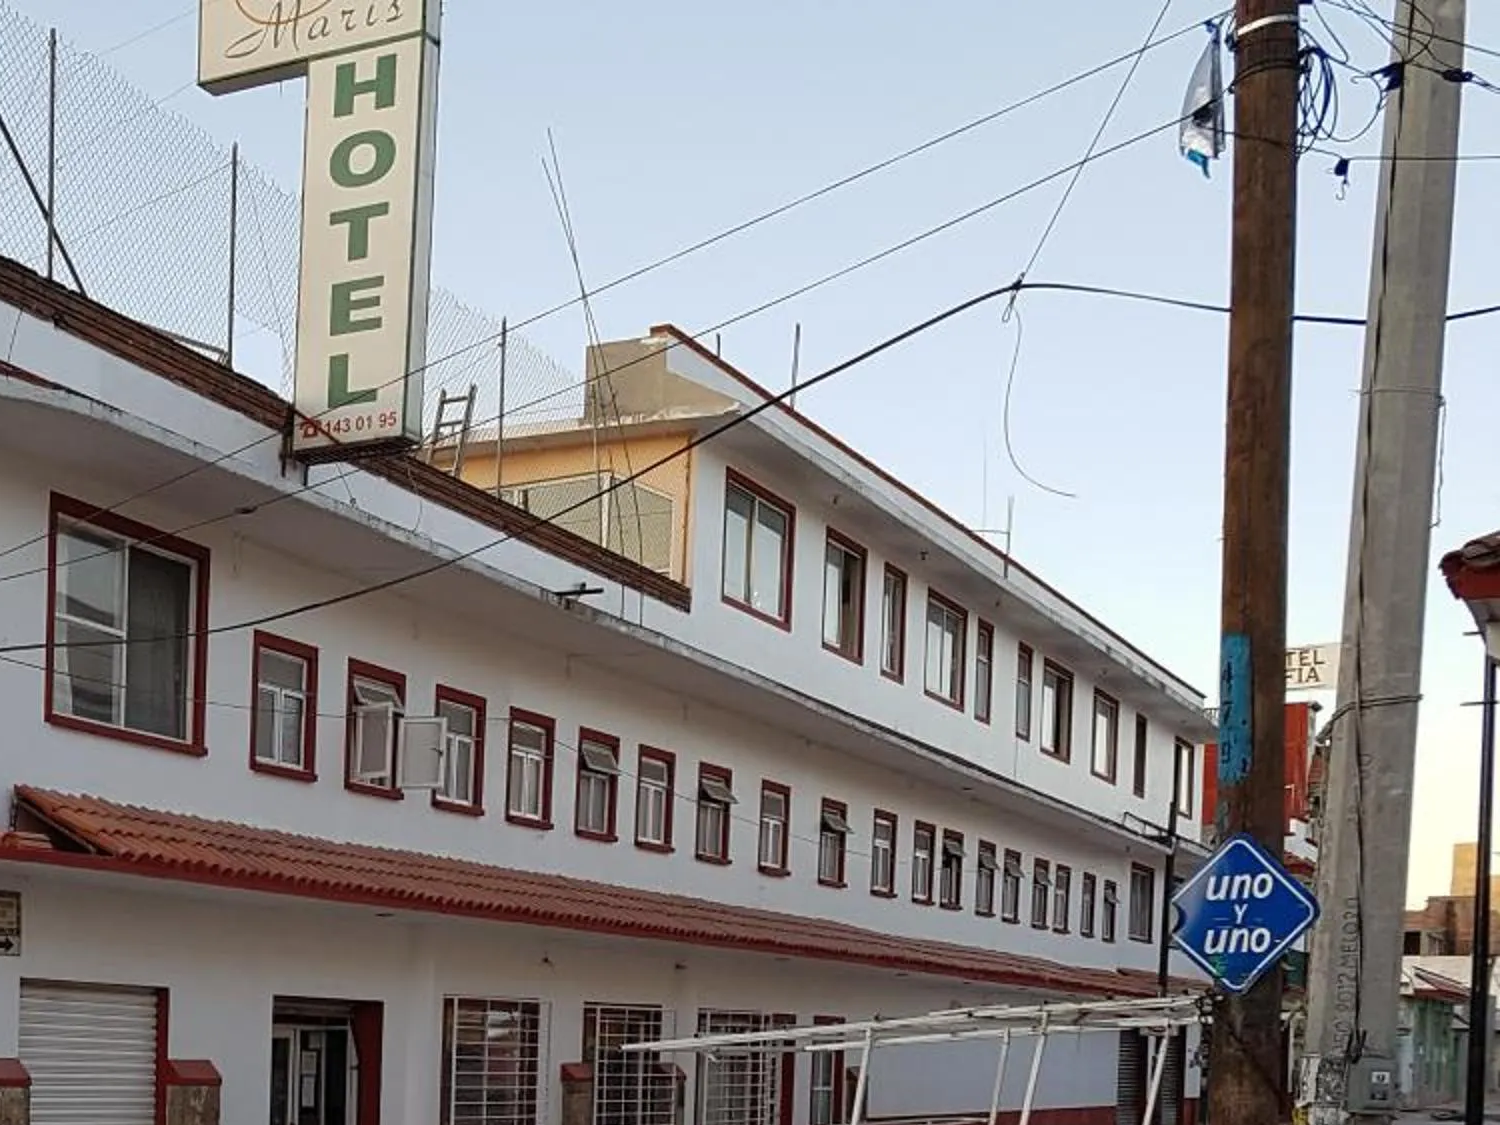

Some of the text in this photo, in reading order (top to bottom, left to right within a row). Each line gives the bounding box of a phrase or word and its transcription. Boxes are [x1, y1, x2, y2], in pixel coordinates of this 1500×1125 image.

[327, 53, 398, 410] HOTEL
[323, 417, 351, 434] 143
[379, 411, 397, 429] 95
[1286, 649, 1325, 667] TEL
[1286, 667, 1320, 684] FIA
[1205, 873, 1274, 901] uno
[1203, 927, 1272, 955] uno
